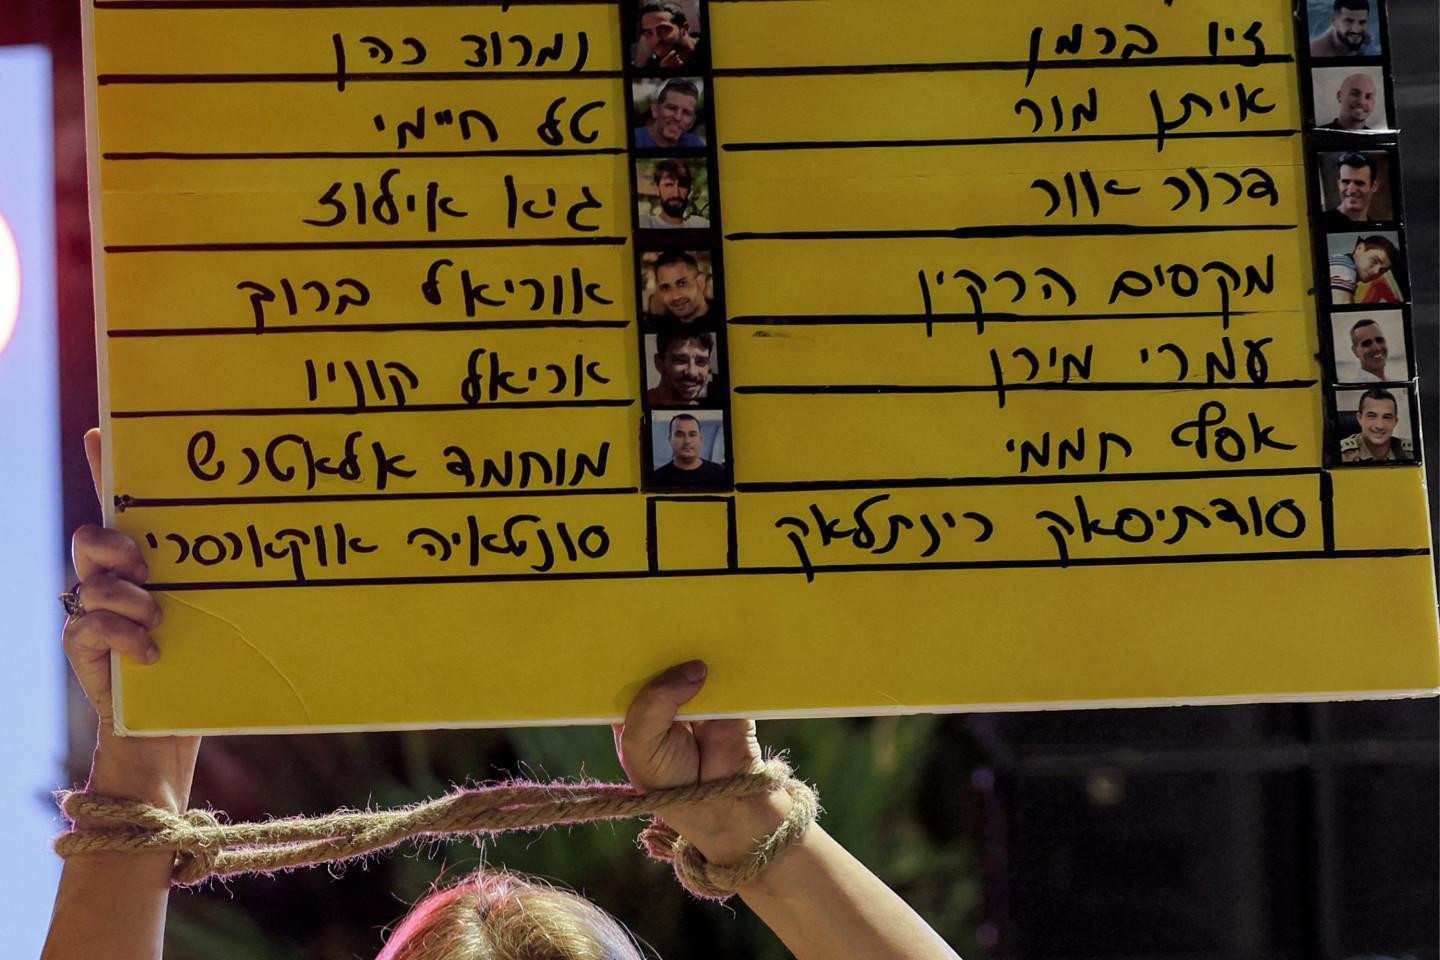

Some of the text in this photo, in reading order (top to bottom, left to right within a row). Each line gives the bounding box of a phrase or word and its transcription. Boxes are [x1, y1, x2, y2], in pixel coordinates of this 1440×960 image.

[331, 30, 589, 93] נמרוד כהן
[1024, 20, 1266, 88] זיו ברמן
[373, 96, 607, 150] טל חיימי
[1014, 82, 1277, 153] איתן מור
[301, 168, 604, 233] גיא אילוז
[1030, 167, 1280, 218] דרור אור
[235, 258, 614, 336] אוריאל ברוך
[918, 254, 1274, 338] מקסים הרקין
[304, 347, 611, 408] אריאל קוניו
[989, 336, 1274, 409] עמרי מירן
[186, 430, 611, 490] מוחמד אלאטרש
[1005, 400, 1298, 473] אסף חממי
[406, 514, 611, 573] סונטאיה
[1035, 494, 1306, 568] סודתיסאק
